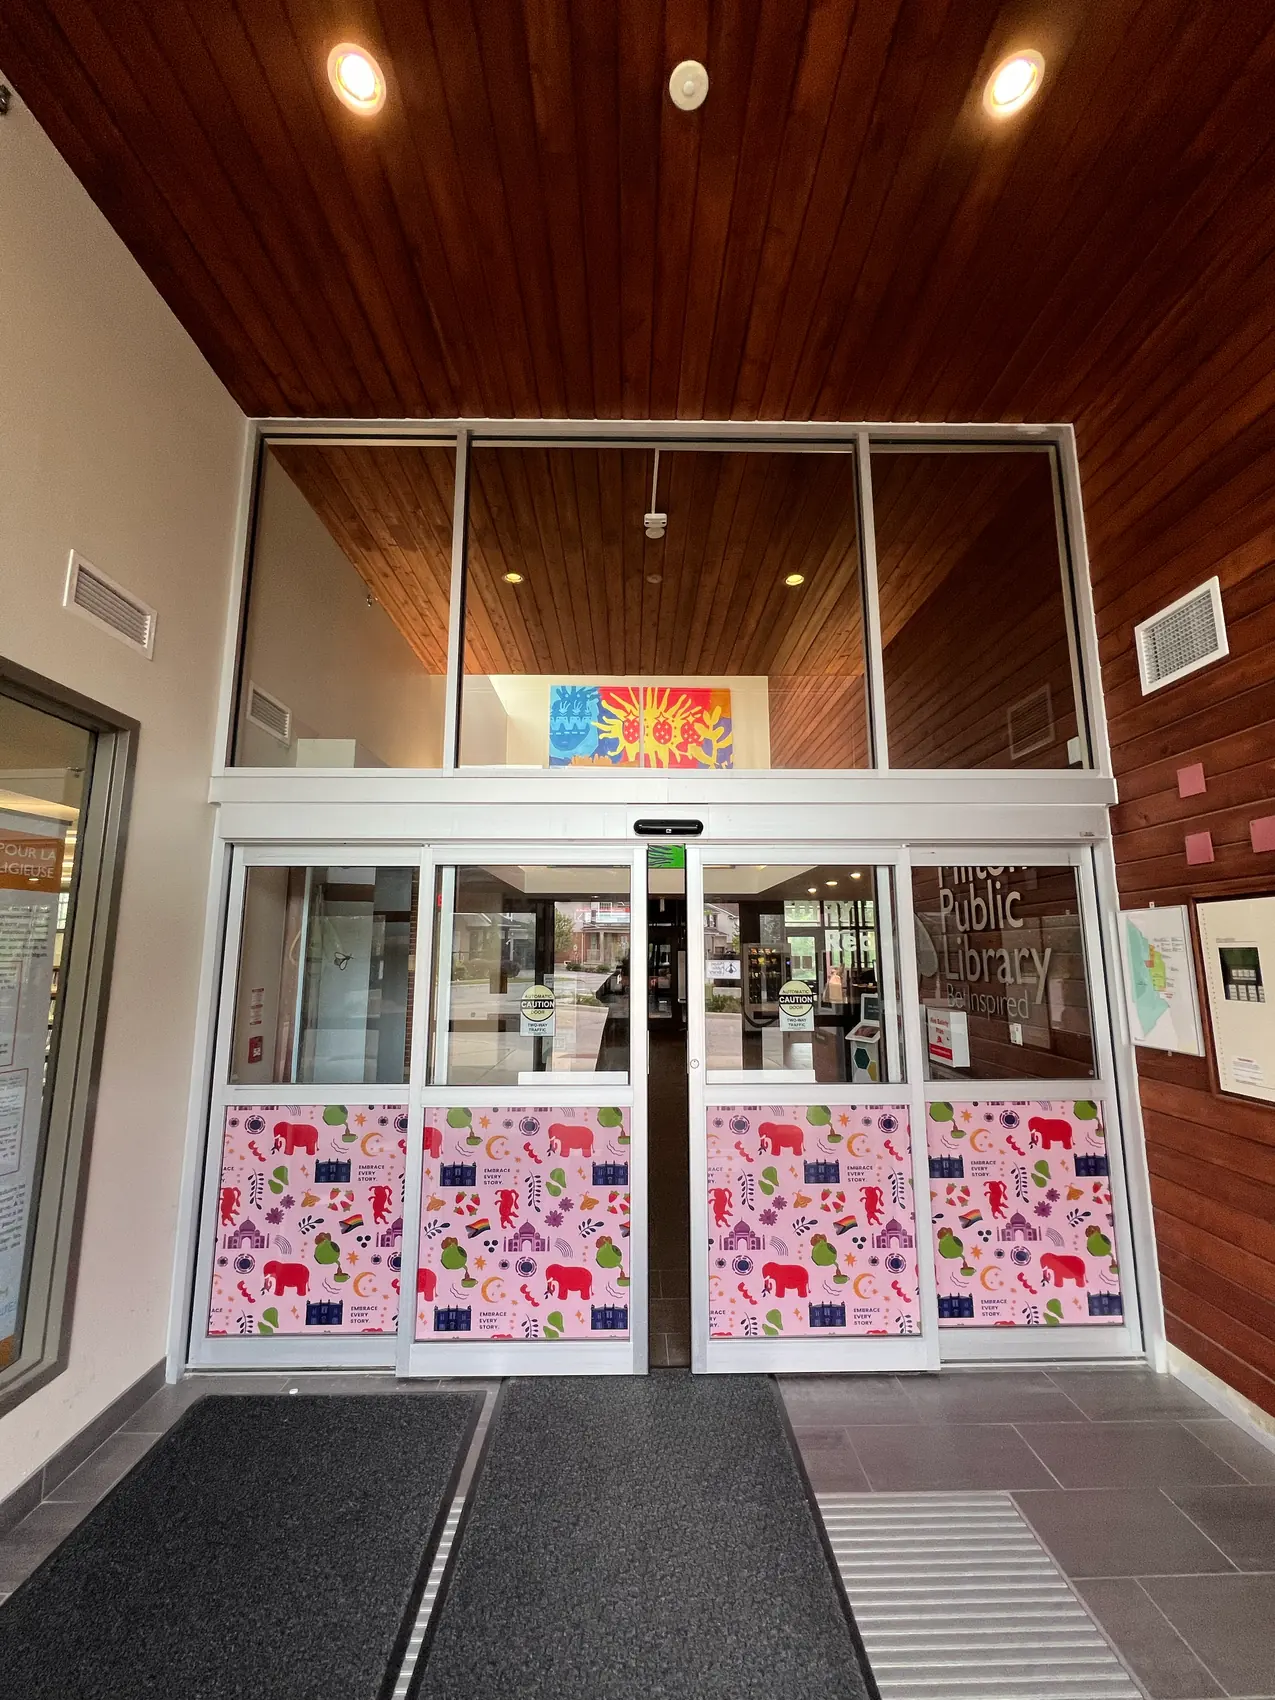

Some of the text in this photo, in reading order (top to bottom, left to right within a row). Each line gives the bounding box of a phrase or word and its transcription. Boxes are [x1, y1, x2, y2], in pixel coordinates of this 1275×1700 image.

[40, 848, 56, 861] LA
[939, 879, 1024, 933] Public
[943, 933, 1051, 1004] Library
[967, 989, 1029, 1020] Inspired
